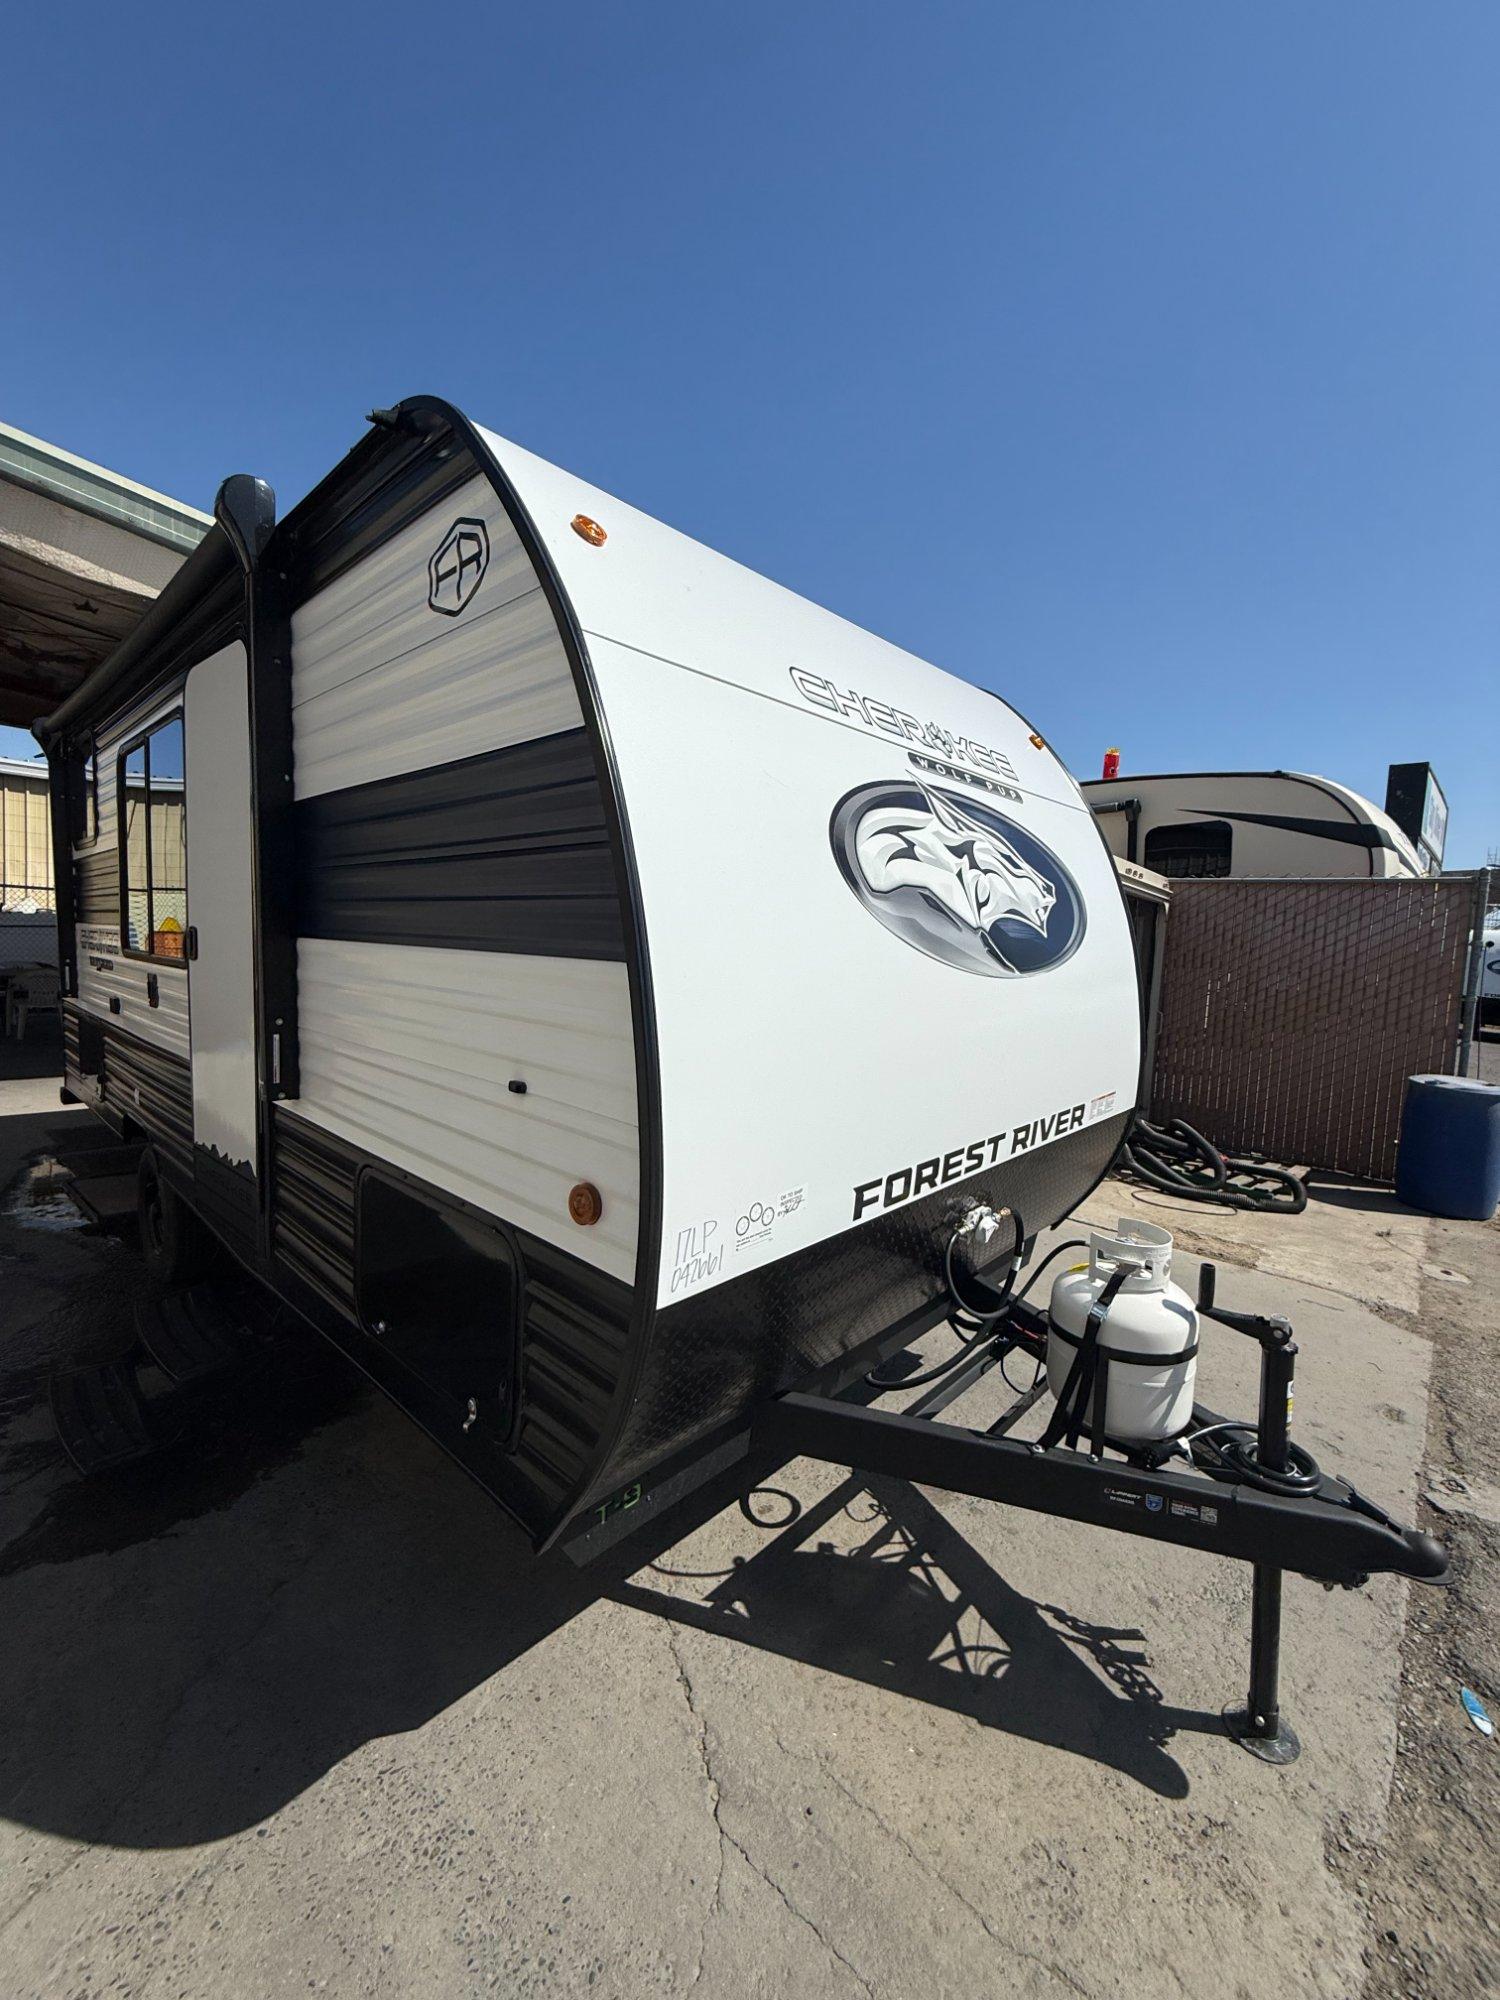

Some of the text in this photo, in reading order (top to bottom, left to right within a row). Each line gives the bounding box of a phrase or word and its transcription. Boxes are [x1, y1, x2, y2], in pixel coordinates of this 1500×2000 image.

[915, 756, 1018, 800] WOLF PUP
[853, 1132, 1006, 1221] FOREST
[1011, 1103, 1086, 1155] RIVER
[675, 1220, 718, 1267] 17LP
